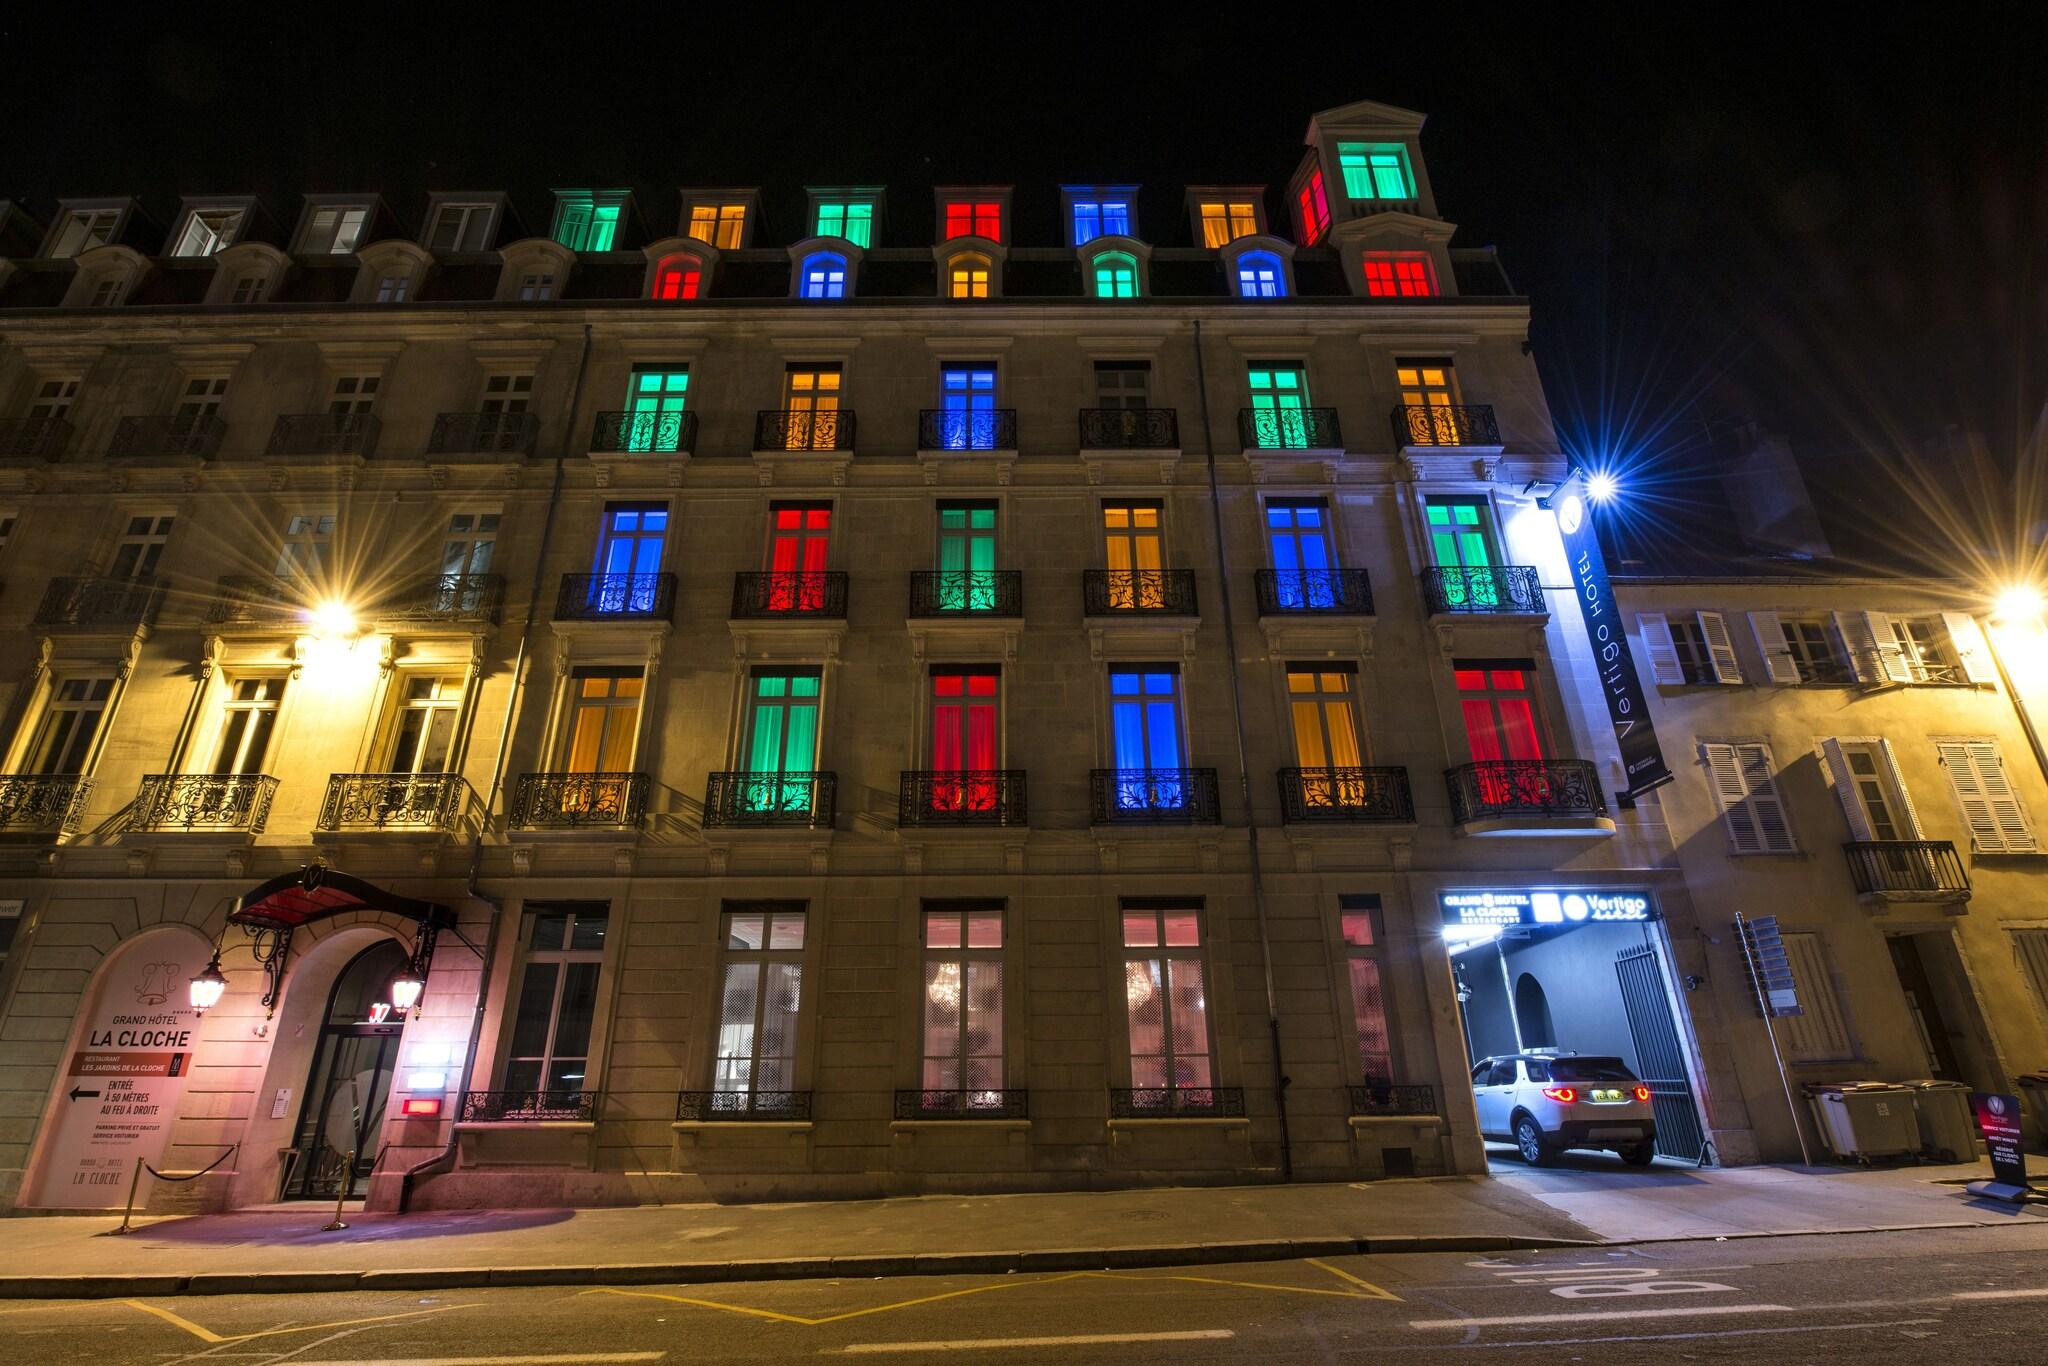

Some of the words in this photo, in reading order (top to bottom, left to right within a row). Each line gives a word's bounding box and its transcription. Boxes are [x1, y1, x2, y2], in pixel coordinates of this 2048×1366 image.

[1577, 550, 1602, 617] HOTEL
[1597, 624, 1635, 739] Vertigo
[1586, 894, 1646, 914] Vertigo
[1460, 907, 1476, 917] LA
[112, 1015, 148, 1025] GRAND
[147, 1013, 178, 1025] HÔTEL
[89, 1030, 112, 1047] LA
[118, 1030, 191, 1047] CLOCHE
[108, 1079, 134, 1090] ENTRÉE
[111, 1093, 120, 1102] 50
[100, 1105, 111, 1115] AU
[112, 1105, 126, 1115] FEU
[133, 1105, 159, 1115] DROITE
